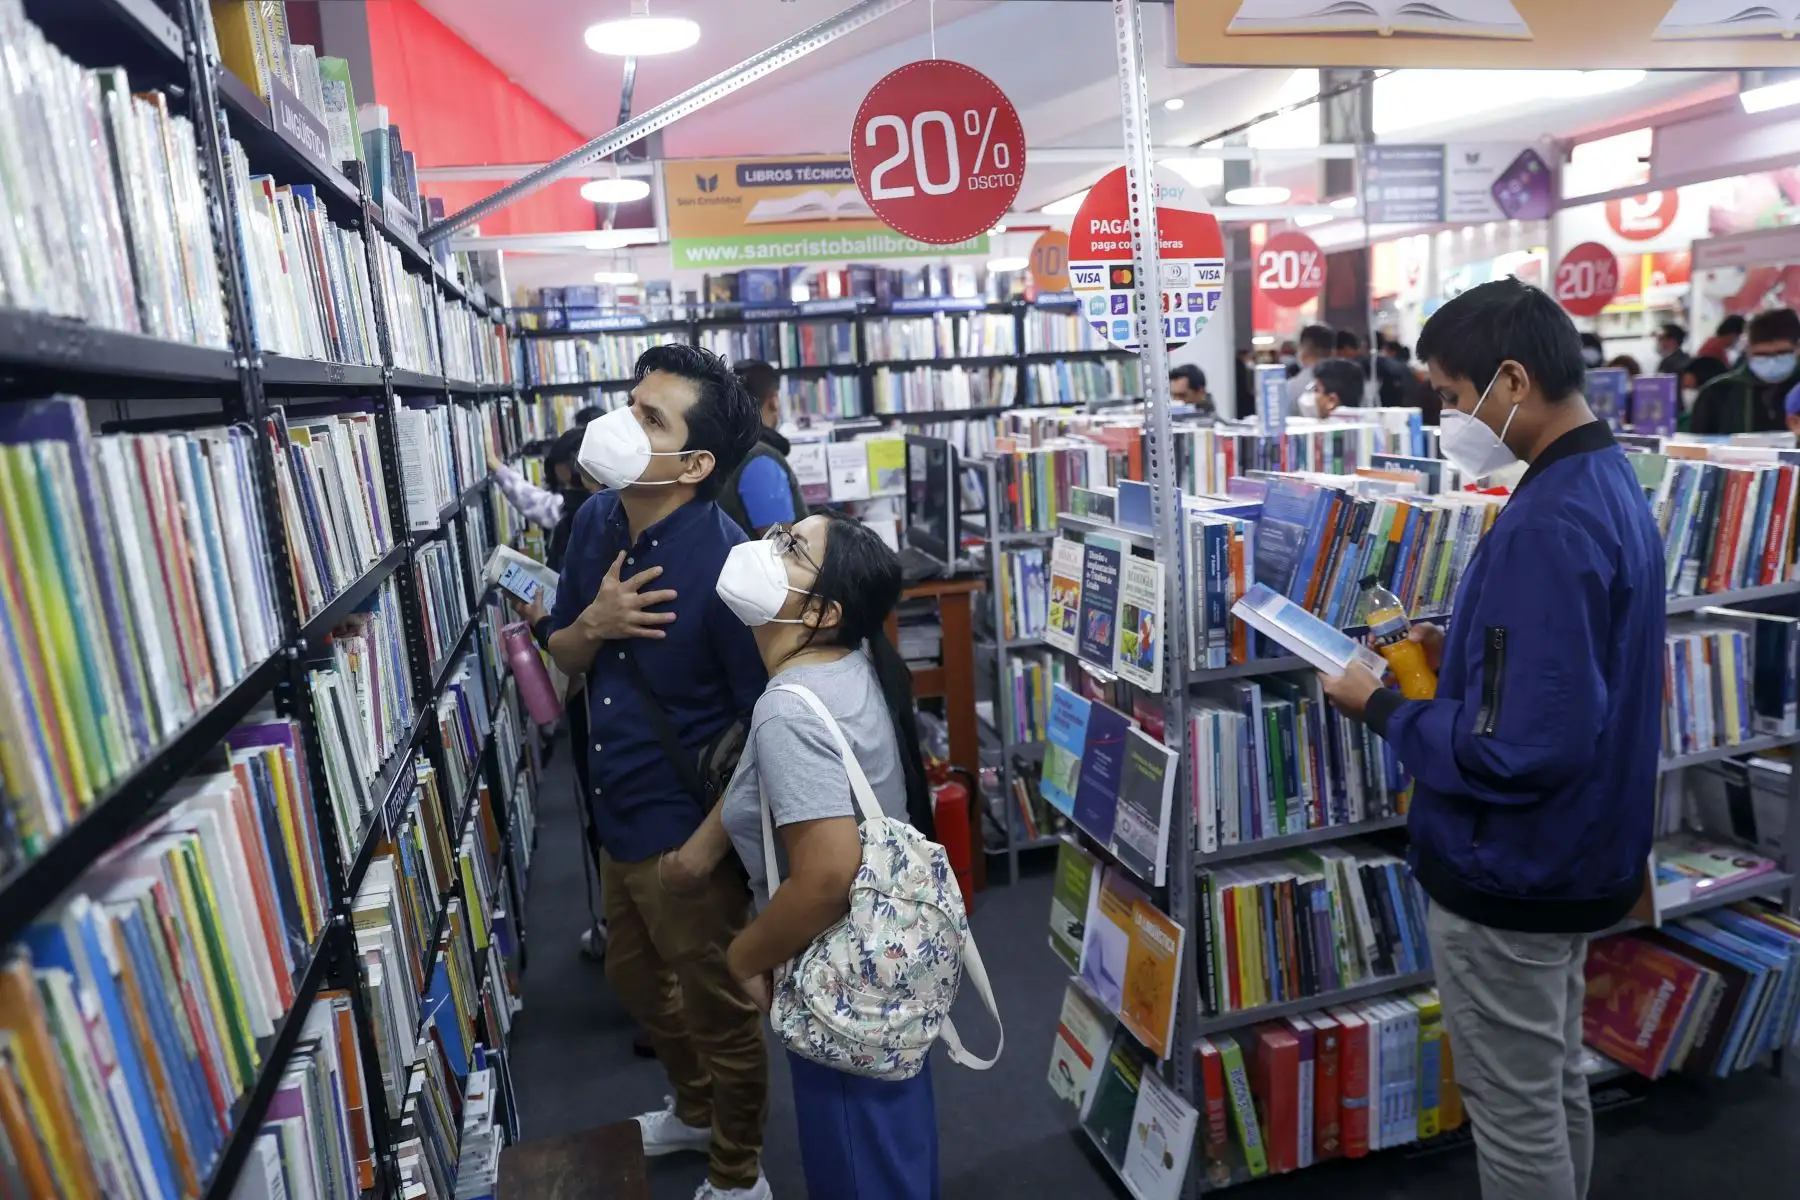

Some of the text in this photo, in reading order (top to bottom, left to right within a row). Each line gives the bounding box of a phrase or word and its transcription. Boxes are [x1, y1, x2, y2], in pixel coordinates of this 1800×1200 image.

[281, 101, 327, 161] LINGÜÍSTICA
[865, 107, 1010, 200] 20%
[745, 166, 852, 182] LIBROS TÉCNICO
[967, 173, 1016, 190] DSCTO
[1156, 183, 1185, 200] ipay
[1090, 219, 1131, 235] PAGA
[1091, 239, 1184, 252] paga co ieras
[1037, 246, 1068, 276] 10
[1076, 272, 1101, 284] VISA
[1199, 269, 1221, 281] VISA
[1259, 250, 1321, 290] 20%
[1557, 260, 1615, 301] 20%
